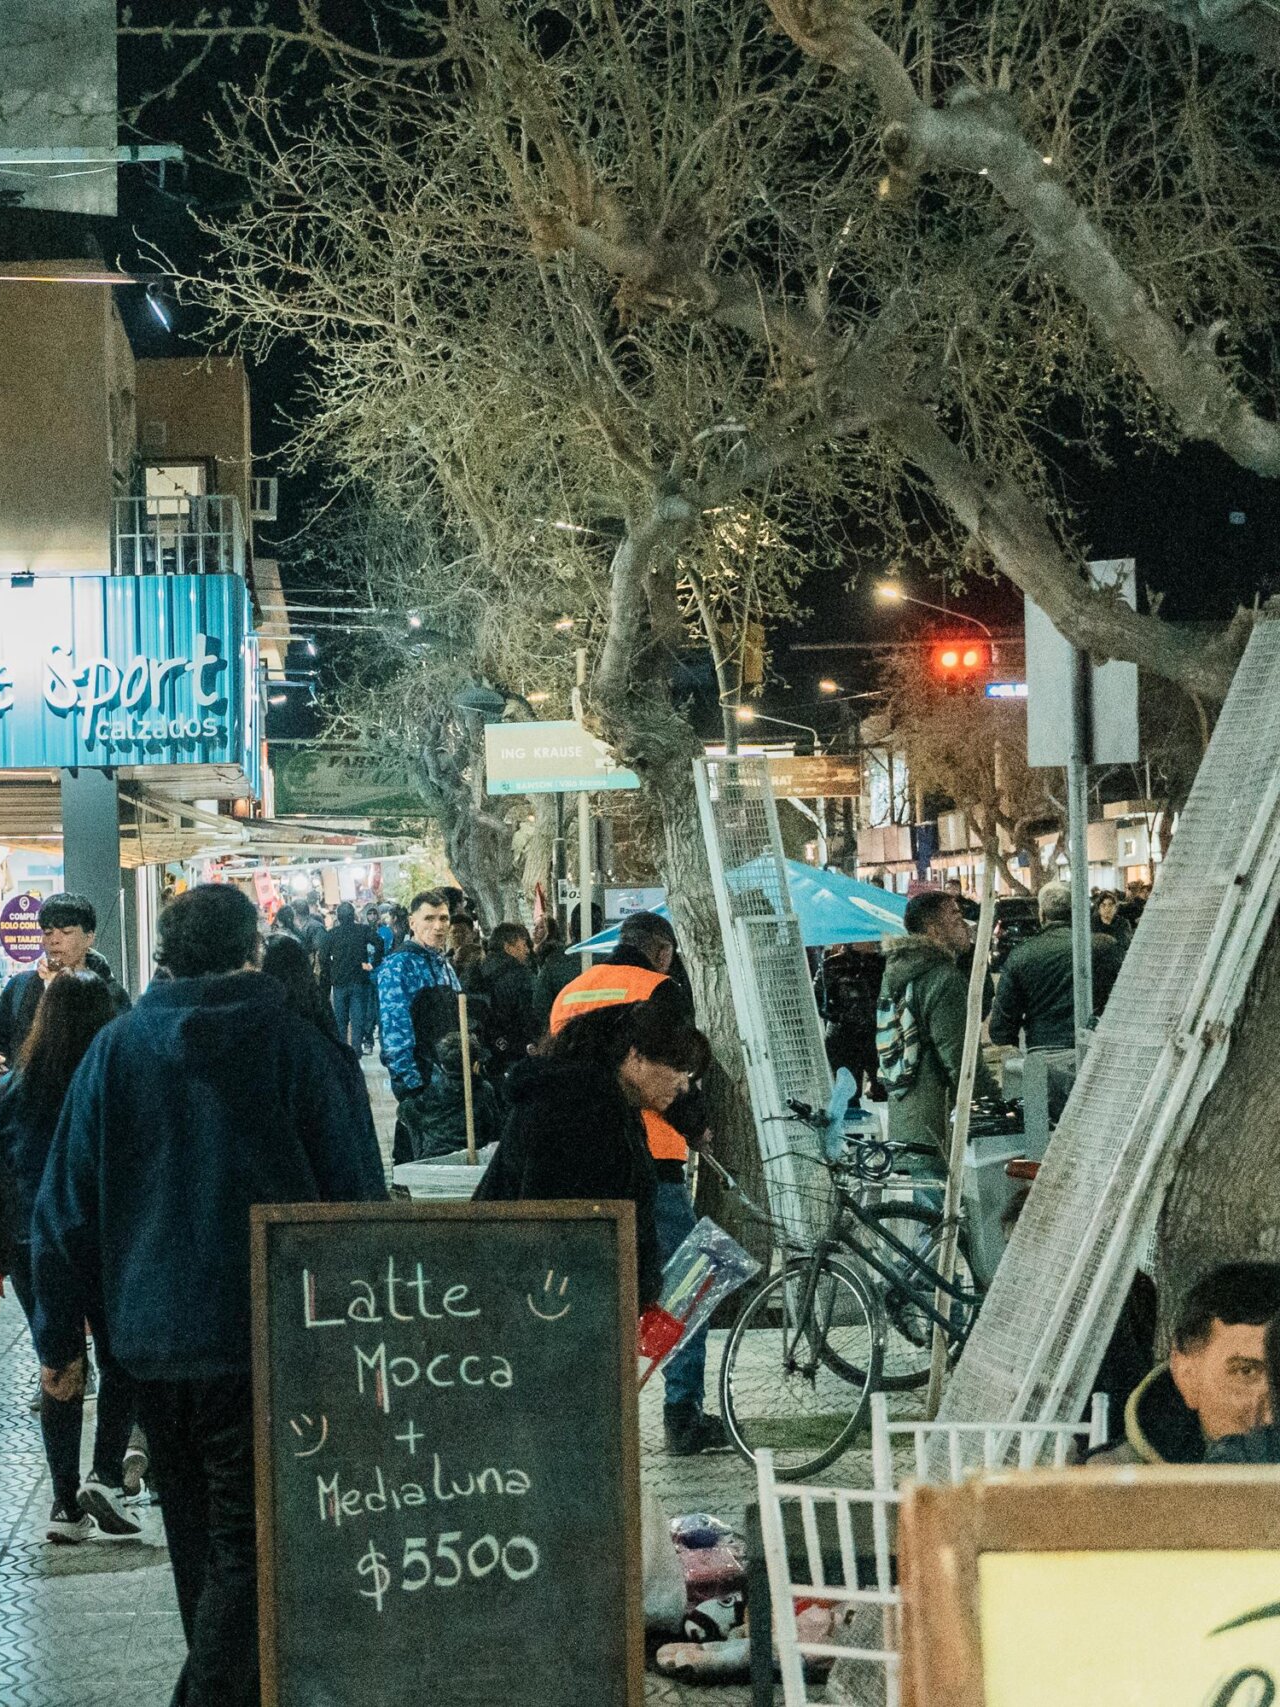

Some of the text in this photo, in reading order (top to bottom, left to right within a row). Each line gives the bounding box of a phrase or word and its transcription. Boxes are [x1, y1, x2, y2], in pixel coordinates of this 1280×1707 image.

[42, 632, 220, 741] Sport
[95, 716, 218, 742] calzados
[501, 745, 584, 760] ING KRAUSE
[303, 1255, 481, 1329] Latte
[354, 1341, 514, 1414] Mocca
[356, 1531, 541, 1612] $5500
